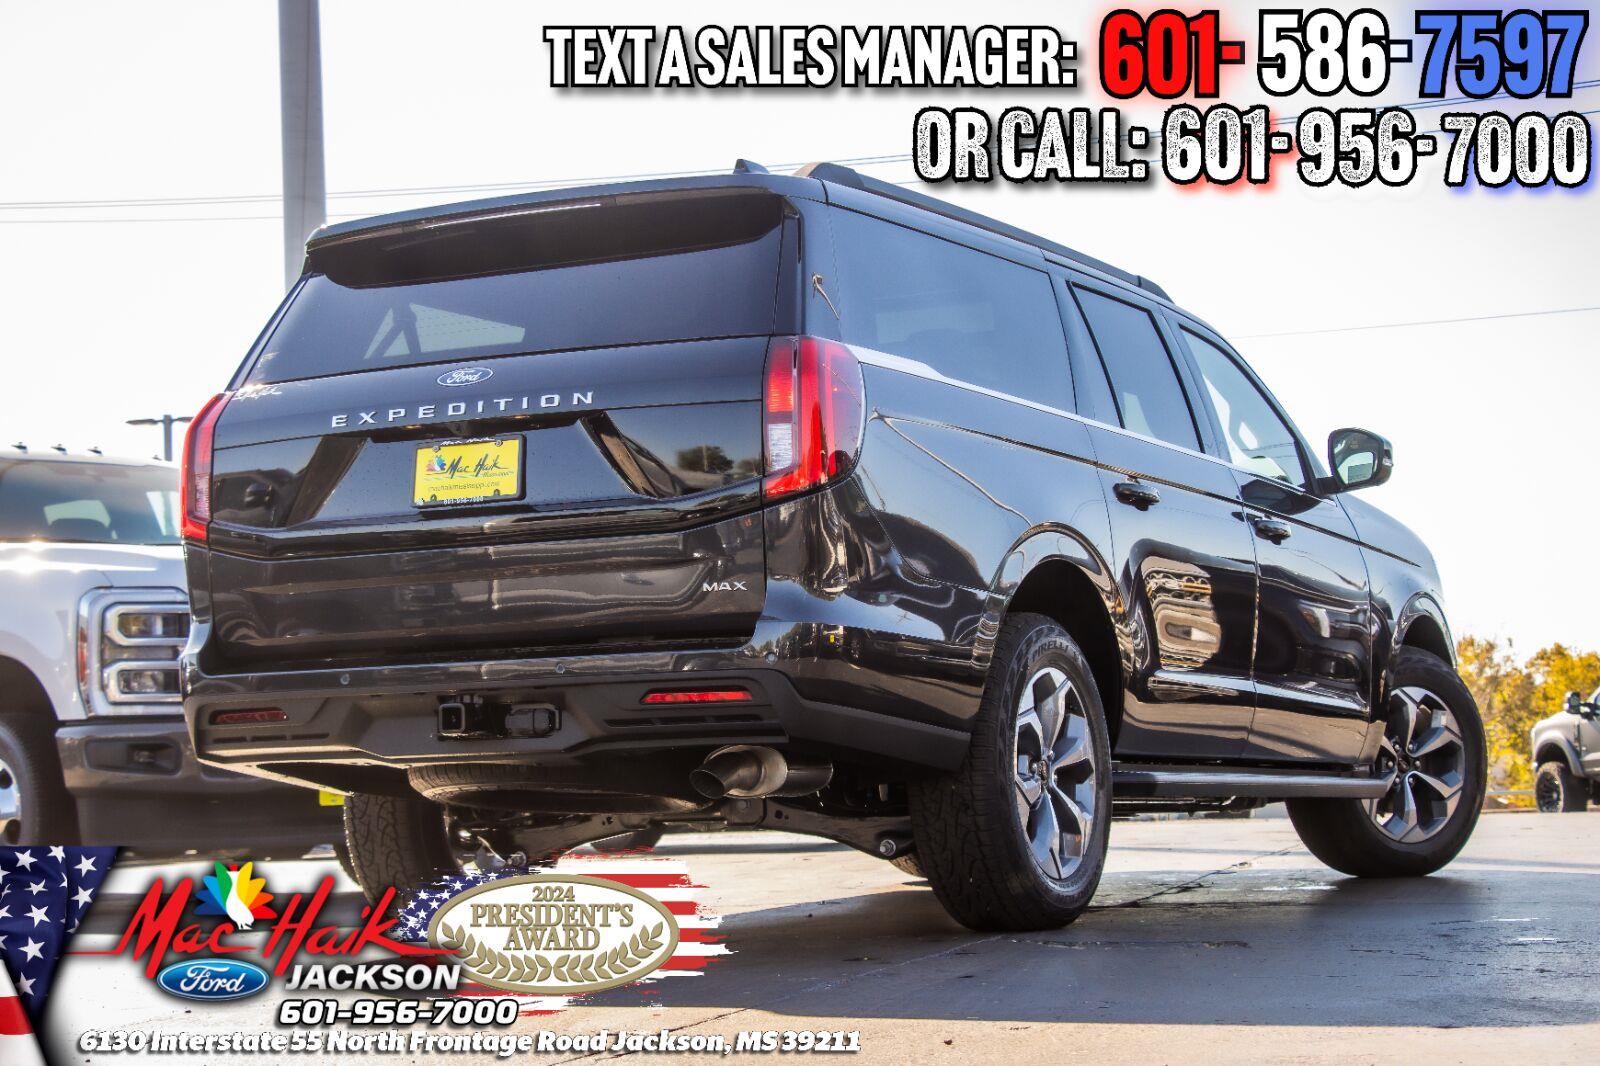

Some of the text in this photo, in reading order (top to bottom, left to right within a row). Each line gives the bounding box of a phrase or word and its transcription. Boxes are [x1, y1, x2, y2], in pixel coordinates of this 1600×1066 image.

[446, 368, 484, 384] Ford
[331, 391, 595, 428] EXPEDITION
[444, 453, 509, 479] Mac Haik
[702, 581, 748, 592] MAX
[1032, 640, 1069, 662] PIRELLI
